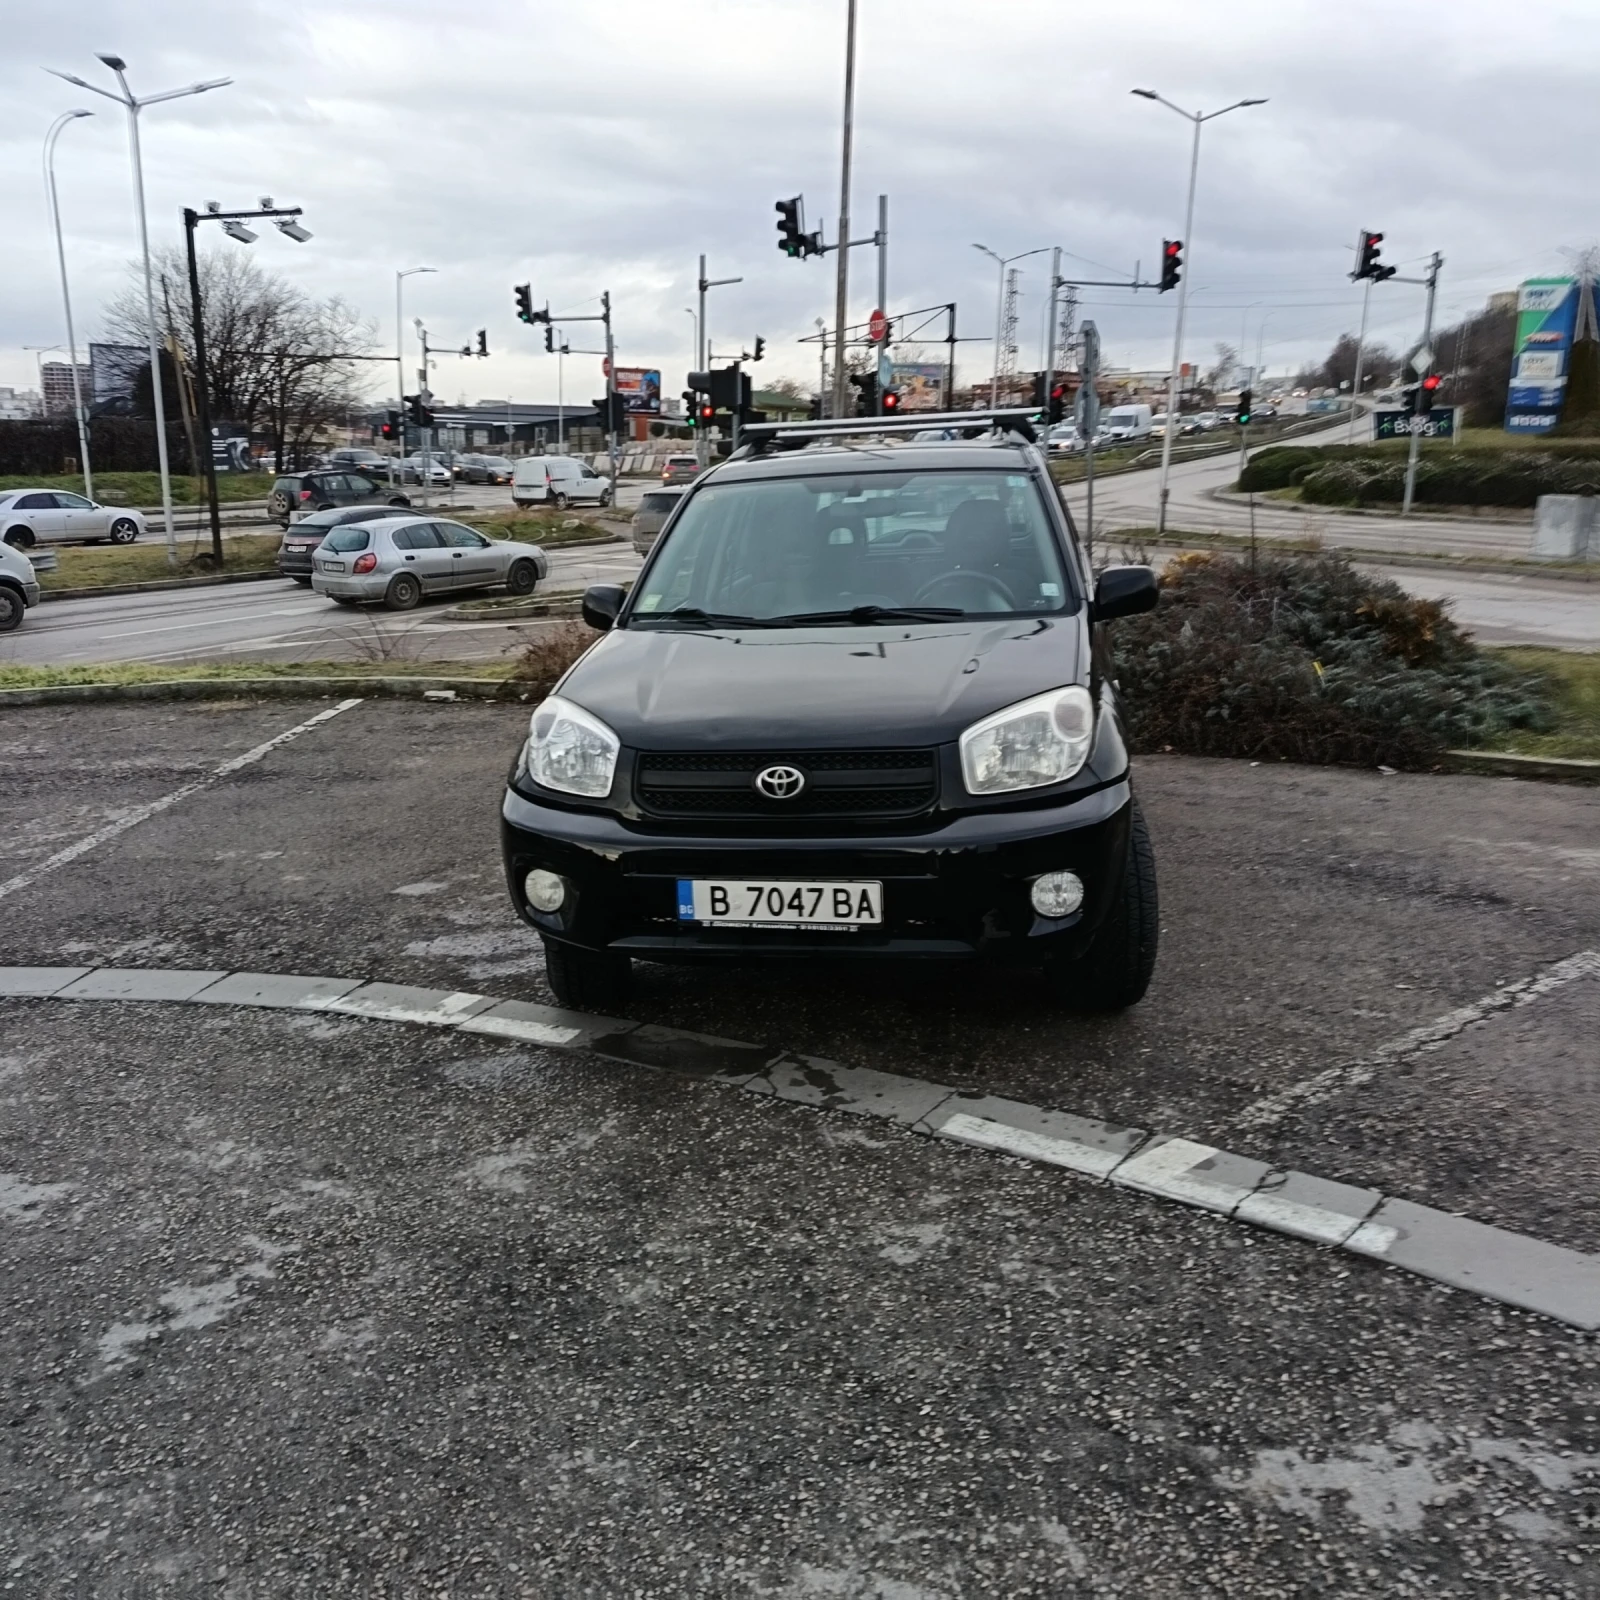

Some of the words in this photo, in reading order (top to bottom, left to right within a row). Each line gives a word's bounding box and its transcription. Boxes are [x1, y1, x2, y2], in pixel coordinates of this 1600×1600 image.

[871, 319, 886, 331] STOP
[709, 885, 730, 916] B
[746, 886, 824, 918] 7047
[833, 887, 876, 919] BA
[679, 904, 693, 914] BG
